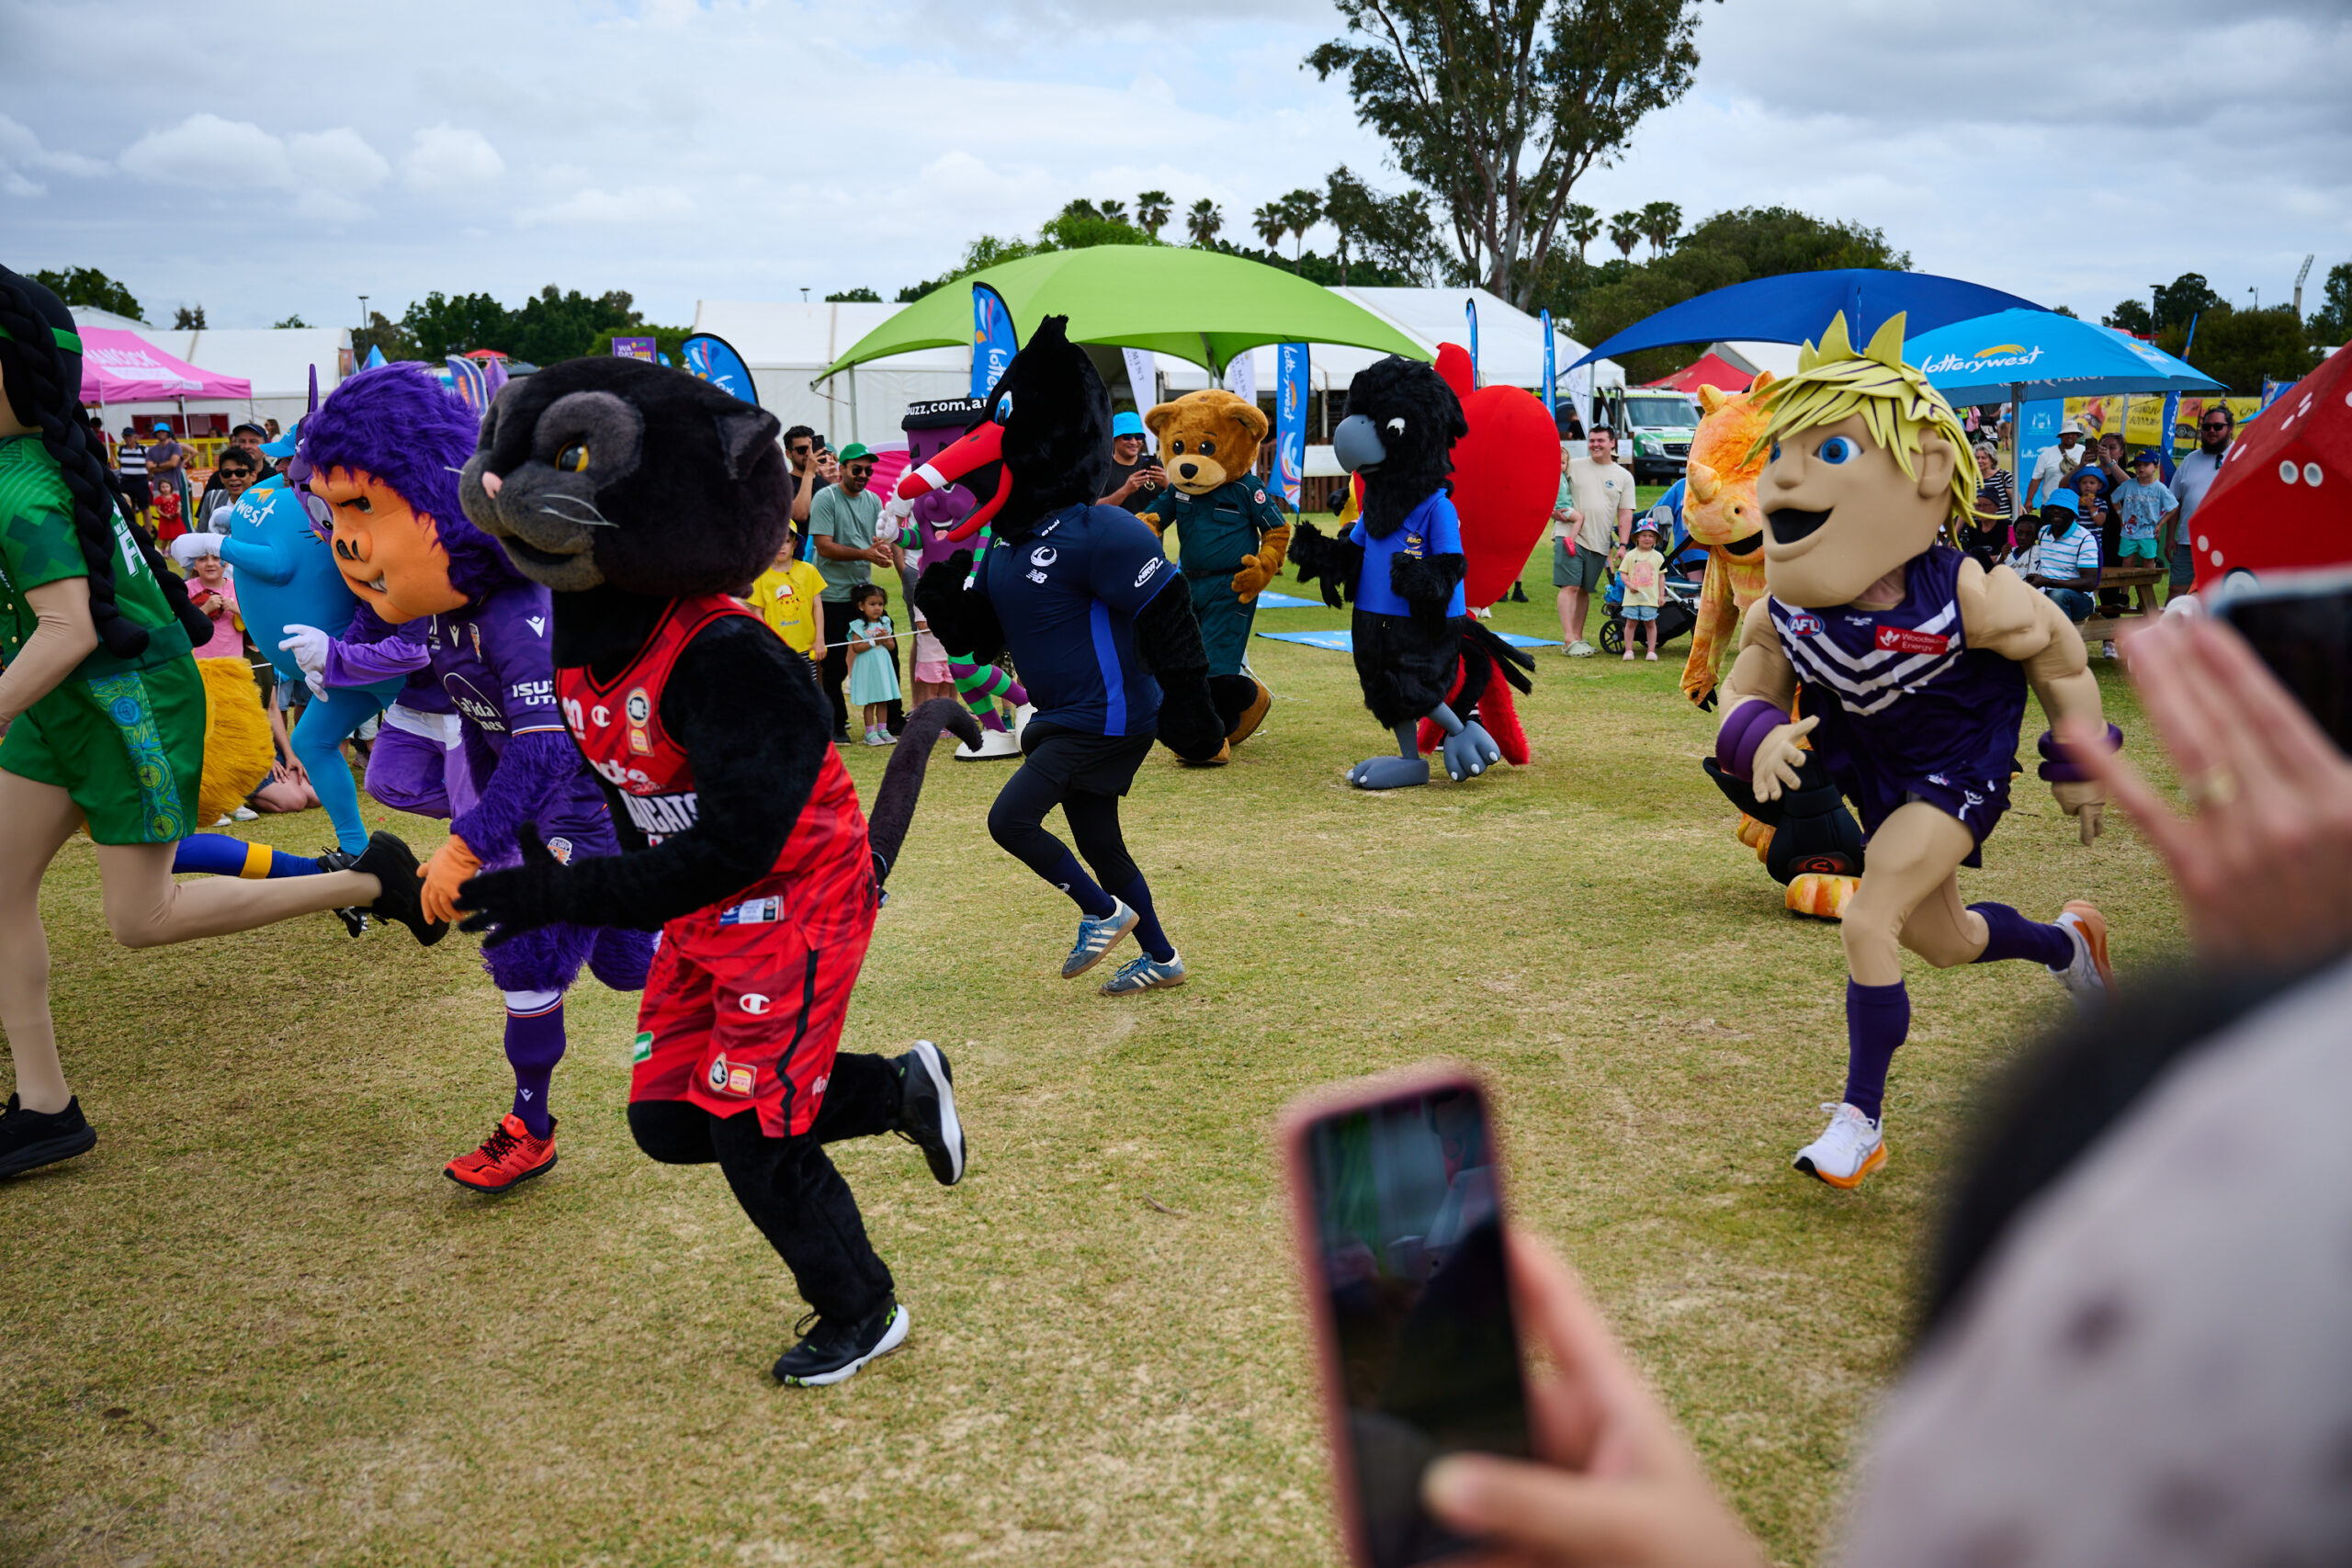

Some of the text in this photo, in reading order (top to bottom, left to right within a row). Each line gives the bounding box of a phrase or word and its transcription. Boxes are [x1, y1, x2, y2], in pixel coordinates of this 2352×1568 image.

[1920, 344, 2045, 374] lotterywest
[1283, 345, 1298, 423] lotterywest
[1137, 562, 1156, 582] NRW
[1790, 619, 1820, 632] AFL
[1902, 642, 1933, 652] Energy
